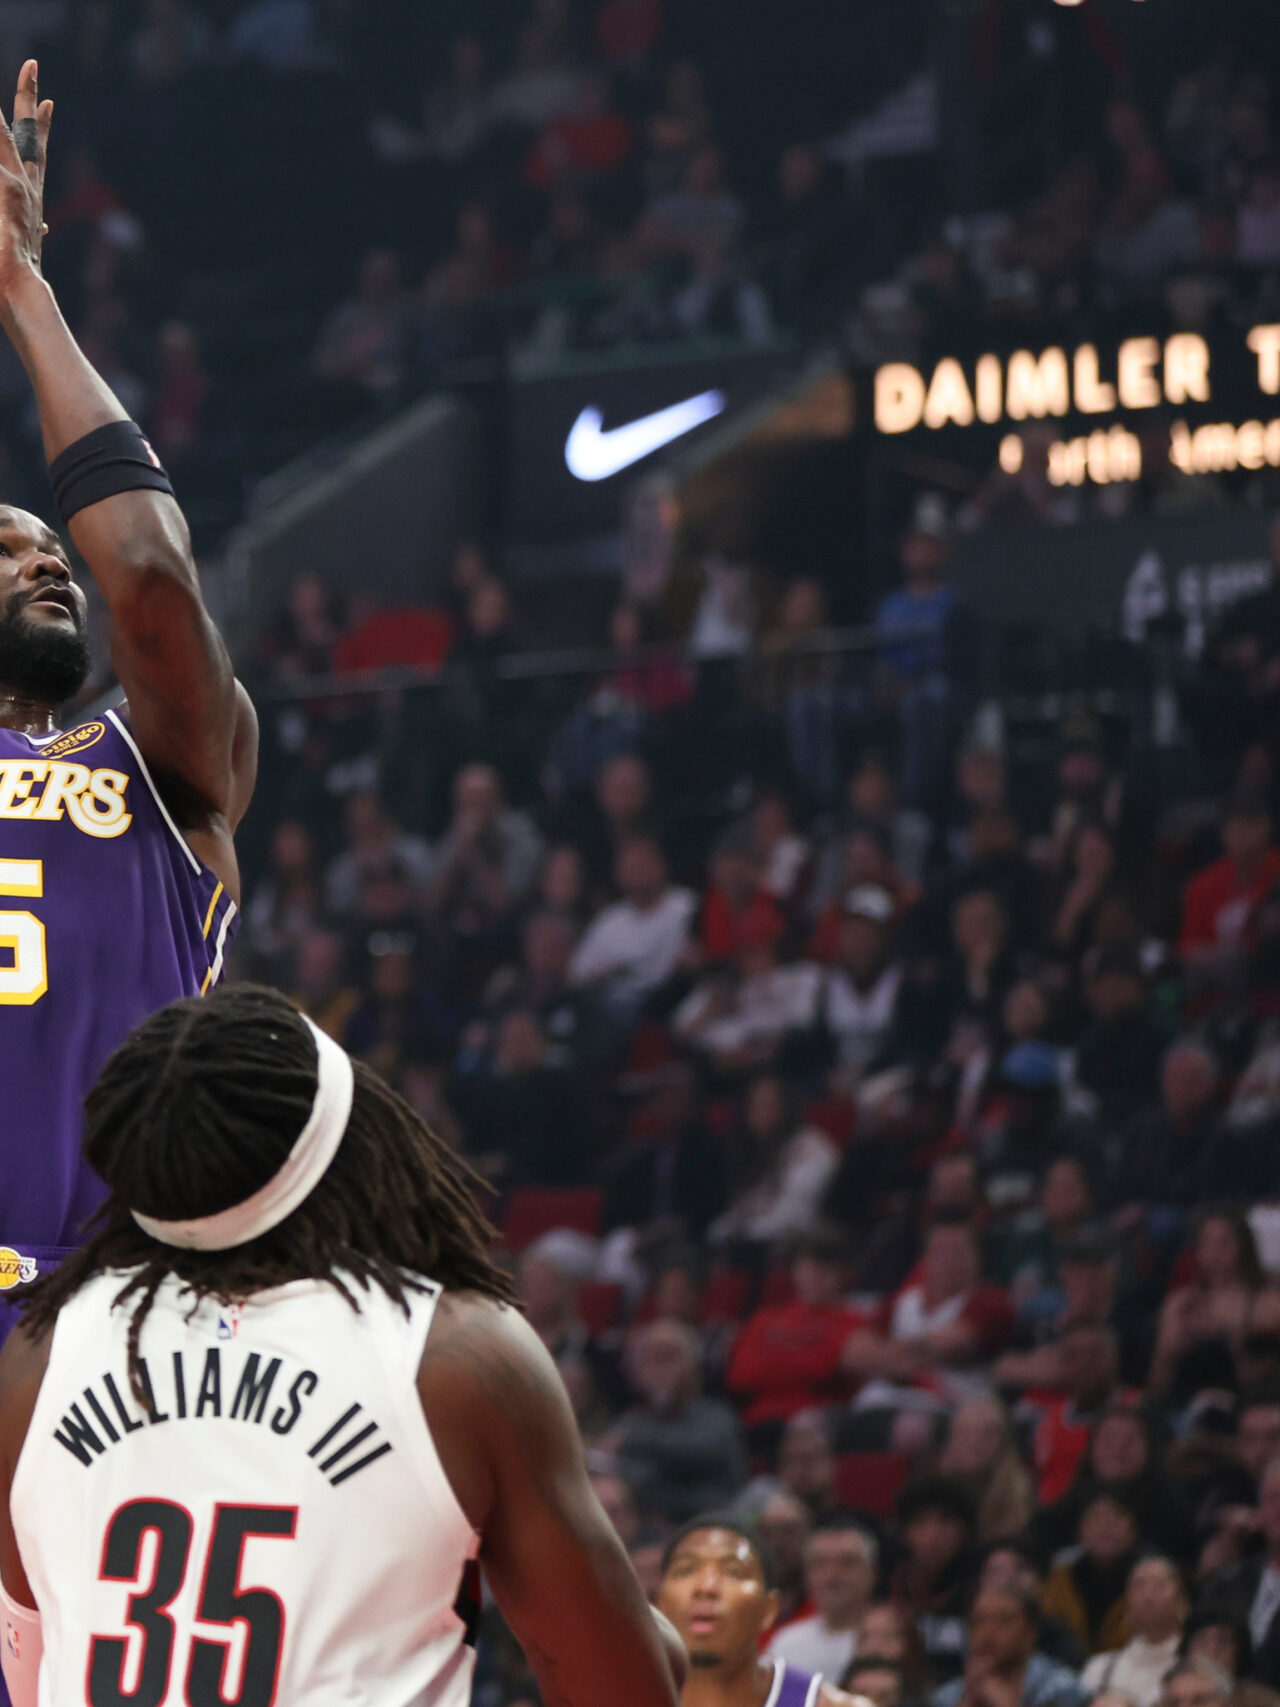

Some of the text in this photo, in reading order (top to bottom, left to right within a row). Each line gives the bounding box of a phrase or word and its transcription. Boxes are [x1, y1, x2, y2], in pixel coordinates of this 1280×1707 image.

[874, 333, 1210, 434] DAIMLER
[40, 725, 100, 757] bibigo
[53, 1347, 392, 1487] WILLIAMS III
[84, 1496, 299, 1707] 35
